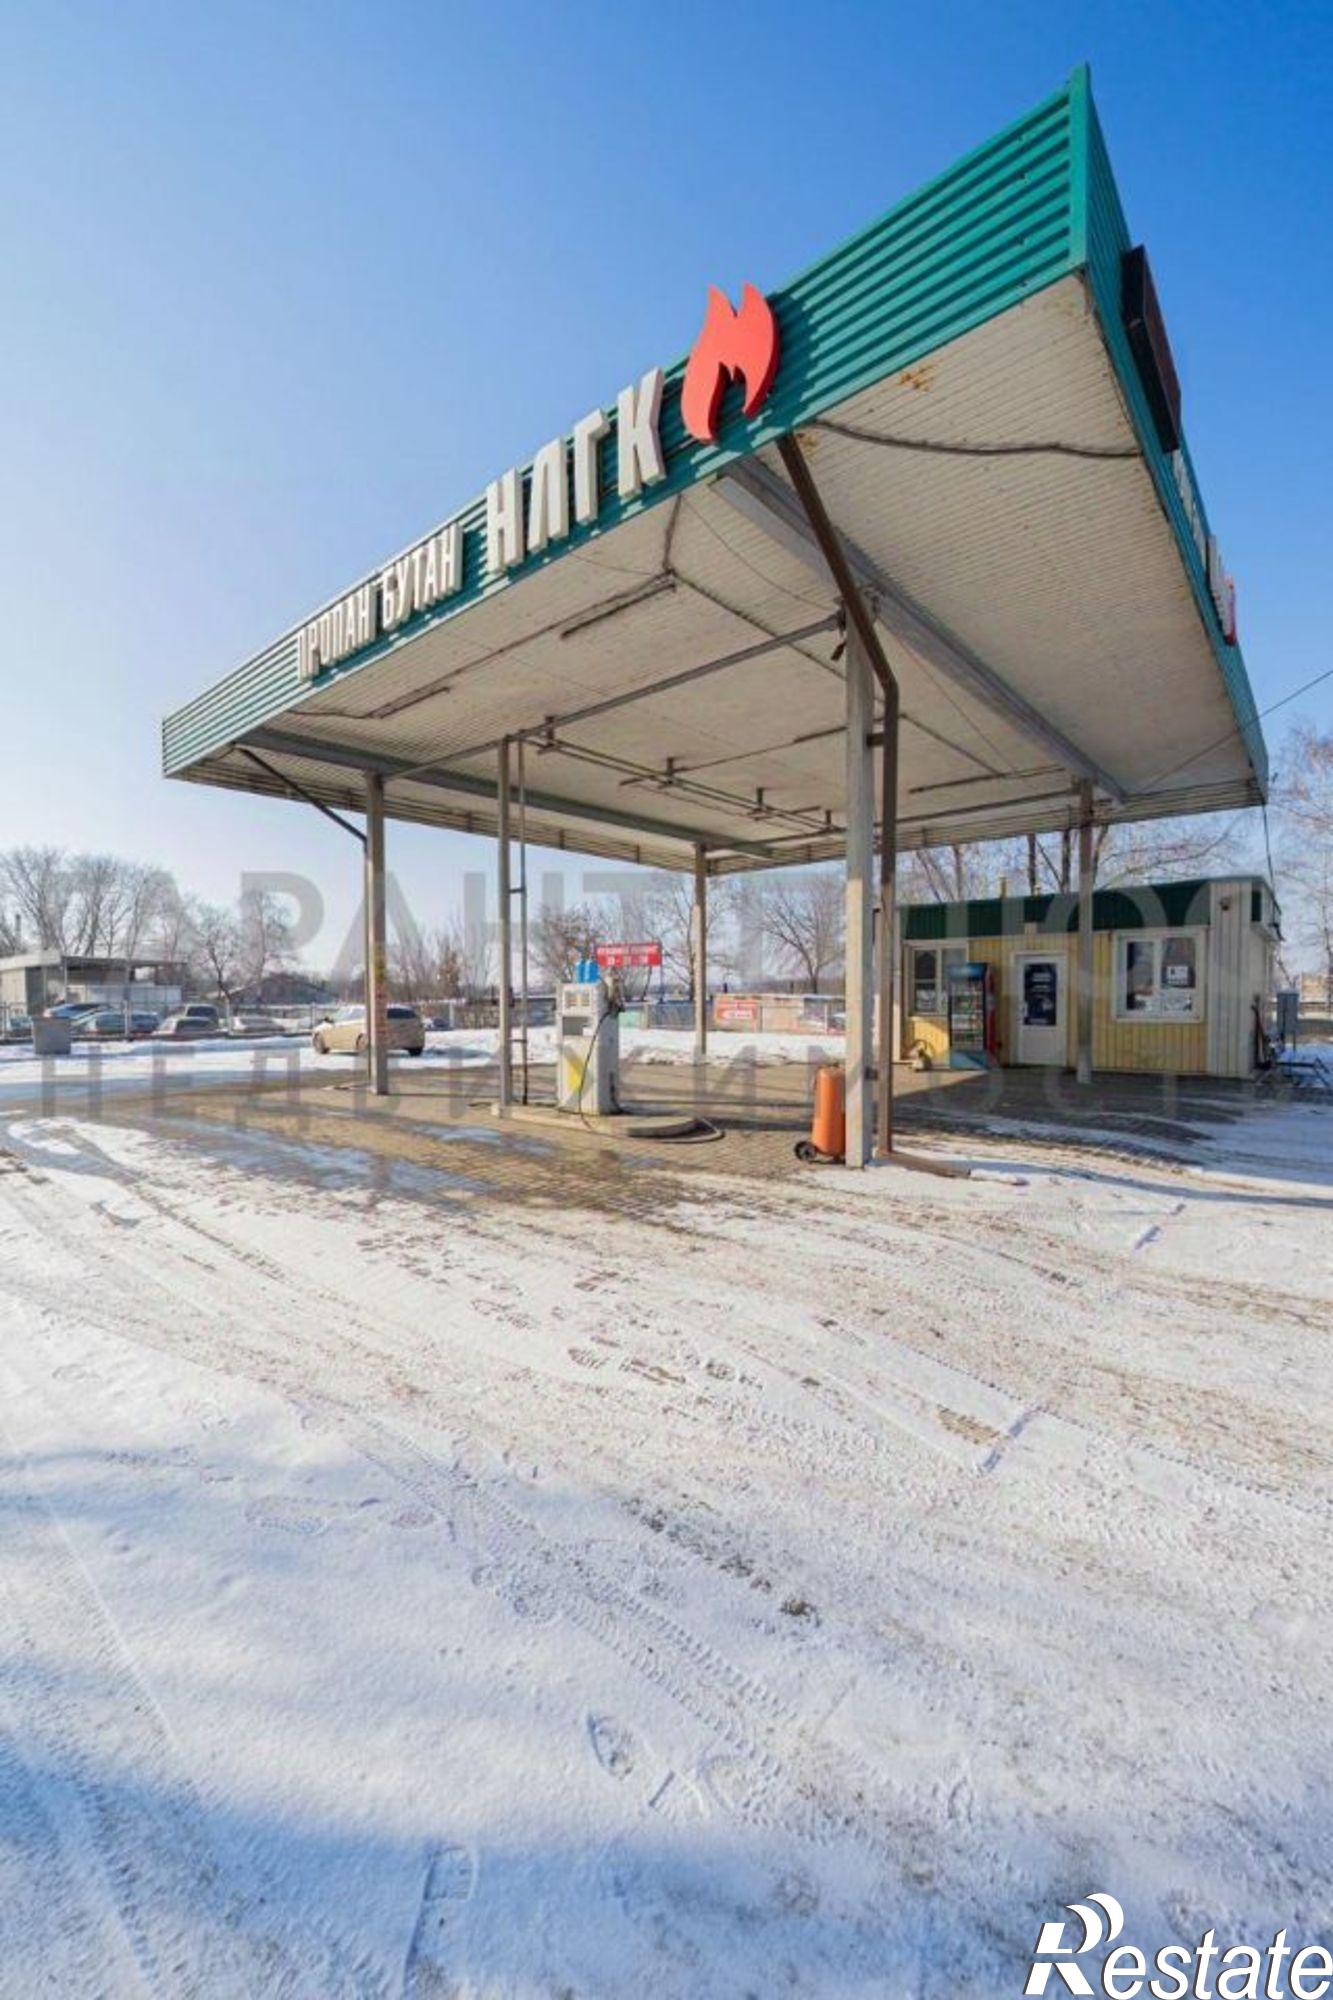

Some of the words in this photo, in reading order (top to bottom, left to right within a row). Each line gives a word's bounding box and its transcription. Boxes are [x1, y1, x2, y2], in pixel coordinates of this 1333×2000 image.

[486, 366, 666, 575] НЛГК
[298, 582, 377, 683] ПРОПАН
[382, 522, 463, 632] БУТАН
